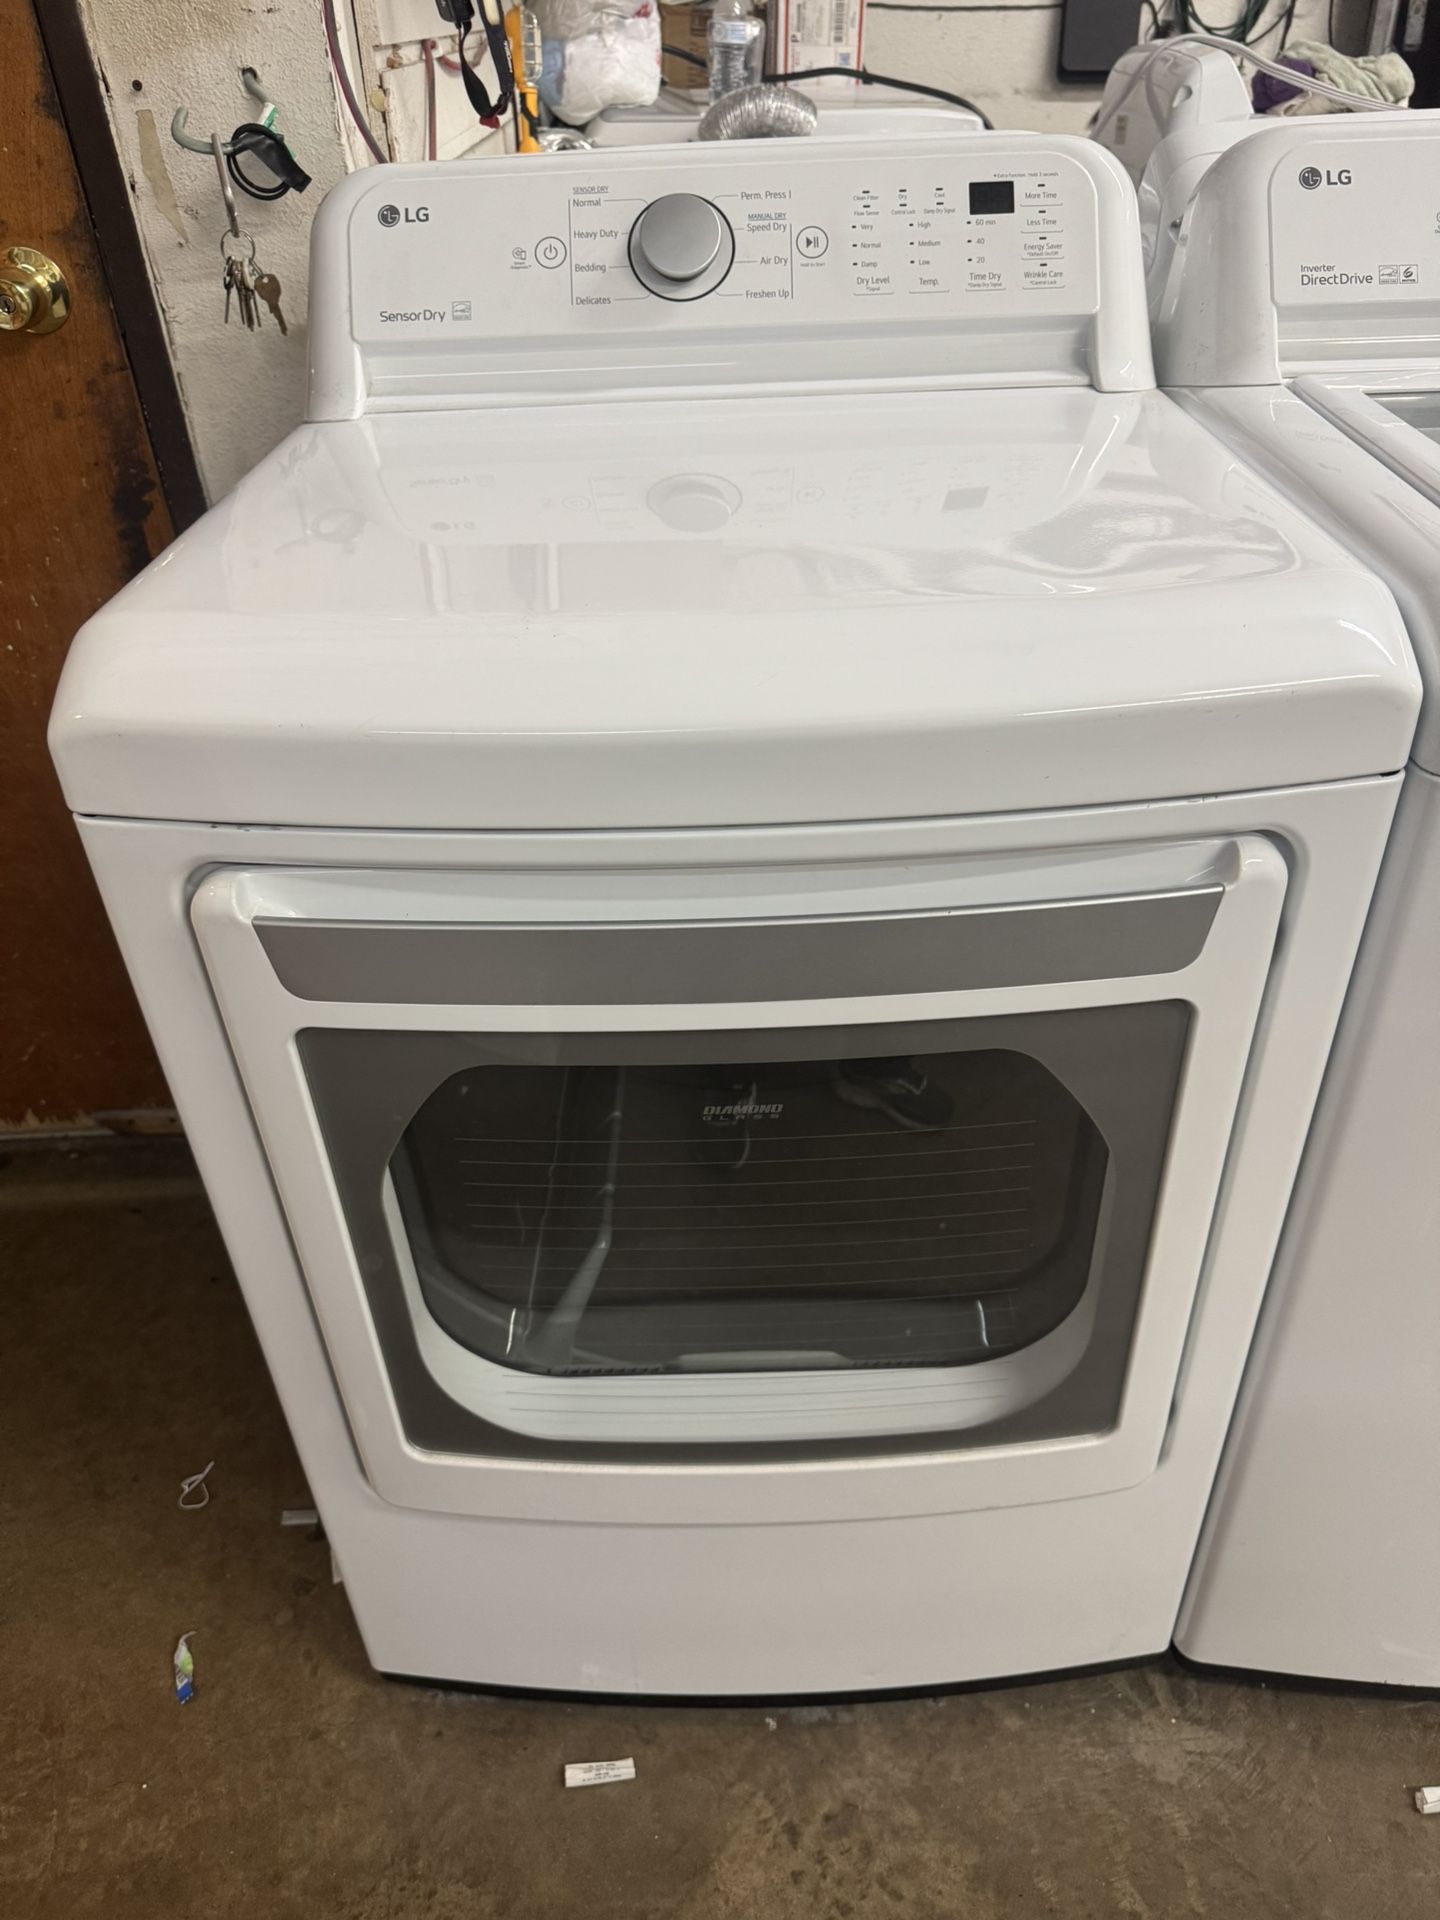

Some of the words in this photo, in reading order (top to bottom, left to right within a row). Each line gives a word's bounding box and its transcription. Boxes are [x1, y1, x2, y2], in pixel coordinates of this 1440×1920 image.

[1326, 169, 1352, 185] LG
[741, 191, 762, 200] Perm.
[765, 190, 787, 200] Press
[1042, 191, 1057, 199] Time
[572, 198, 601, 207] Normal
[404, 206, 430, 223] LG
[748, 212, 772, 220] MANUAL
[918, 221, 931, 229] High
[1042, 218, 1057, 226] Time
[747, 222, 771, 233] Speed
[773, 222, 788, 232] Dry
[860, 223, 873, 231] Very
[574, 230, 598, 240] Heavy
[599, 229, 618, 239] Duty
[1024, 243, 1044, 252] Energy
[760, 256, 771, 265] Air
[774, 256, 788, 267] Dry
[976, 256, 985, 264] 20
[574, 264, 606, 274] Bedding
[861, 261, 878, 269] Damp
[1300, 264, 1335, 272] Inverter
[969, 272, 987, 280] Time
[988, 272, 1001, 282] Dry
[1024, 271, 1048, 279] Wrinkle
[1048, 270, 1063, 278] Care
[857, 276, 870, 286] Dry
[871, 275, 890, 285] Level
[919, 277, 939, 286] Temp.
[745, 289, 776, 299] Freshen
[778, 289, 790, 299] Up
[575, 296, 611, 305] Delicates
[703, 1103, 784, 1115] DIAMOND
